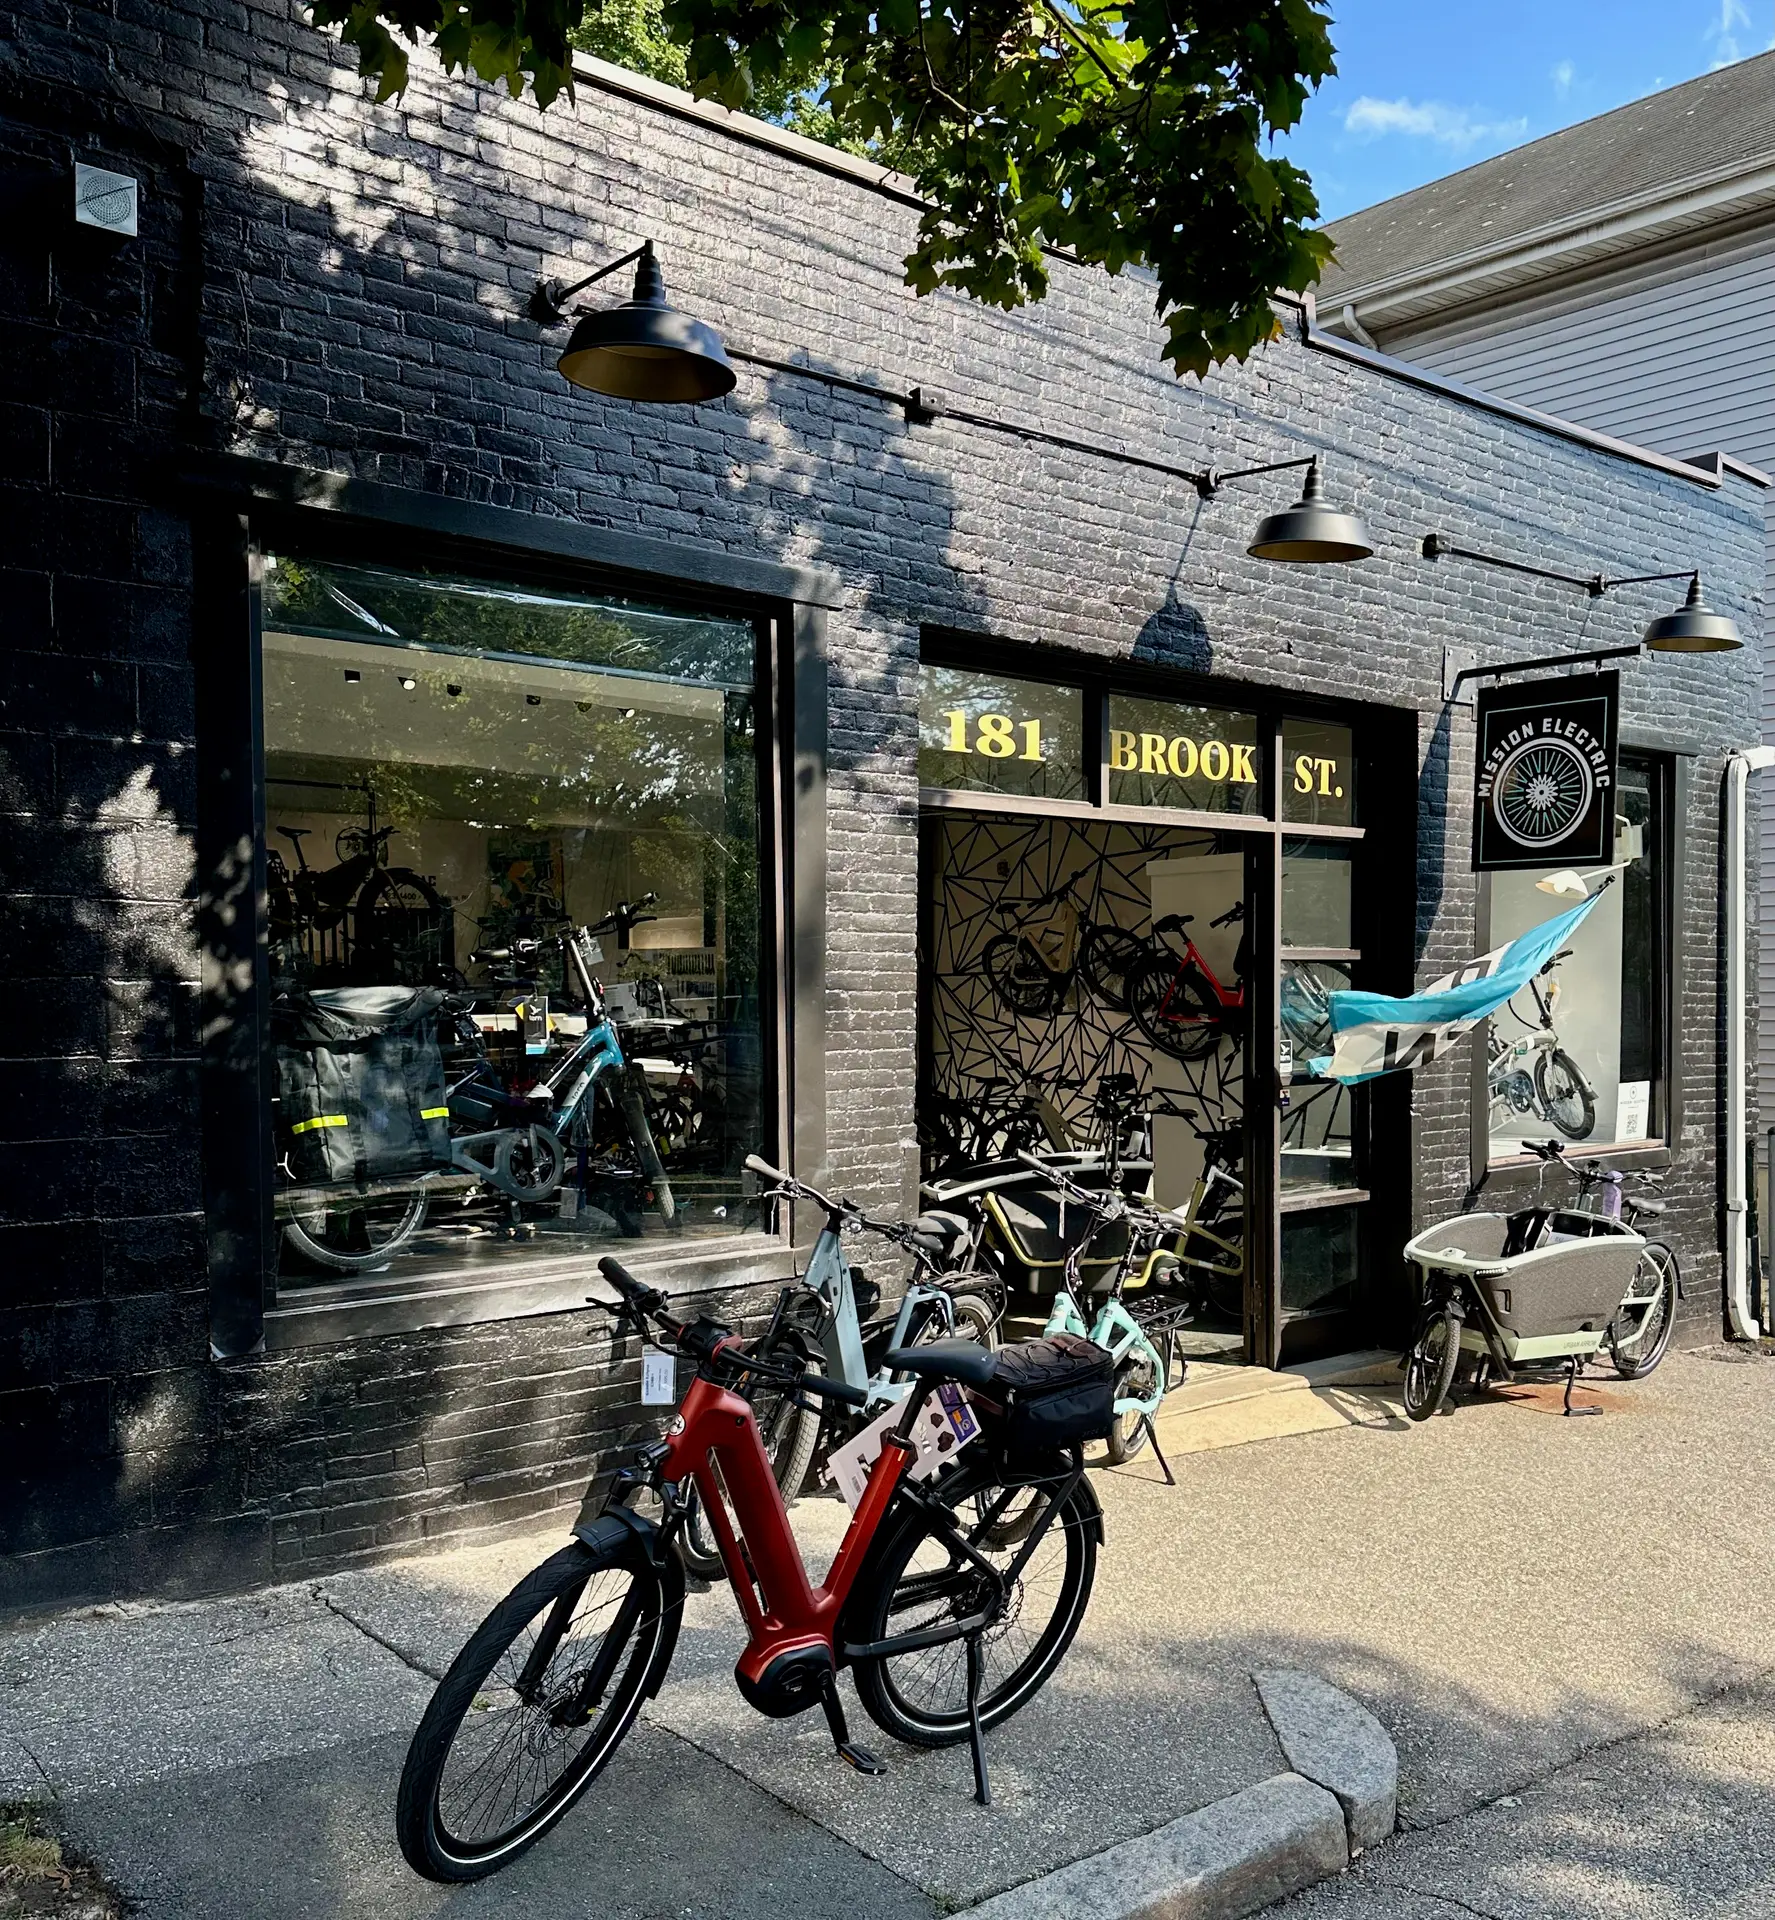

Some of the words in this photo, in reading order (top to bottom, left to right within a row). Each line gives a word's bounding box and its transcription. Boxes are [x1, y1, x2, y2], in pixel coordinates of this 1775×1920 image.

[942, 709, 1047, 763] 181
[1108, 728, 1258, 785] BROOK
[1293, 754, 1344, 799] ST.
[1477, 721, 1535, 798] MISSION
[1541, 717, 1611, 788] ELECTRIC
